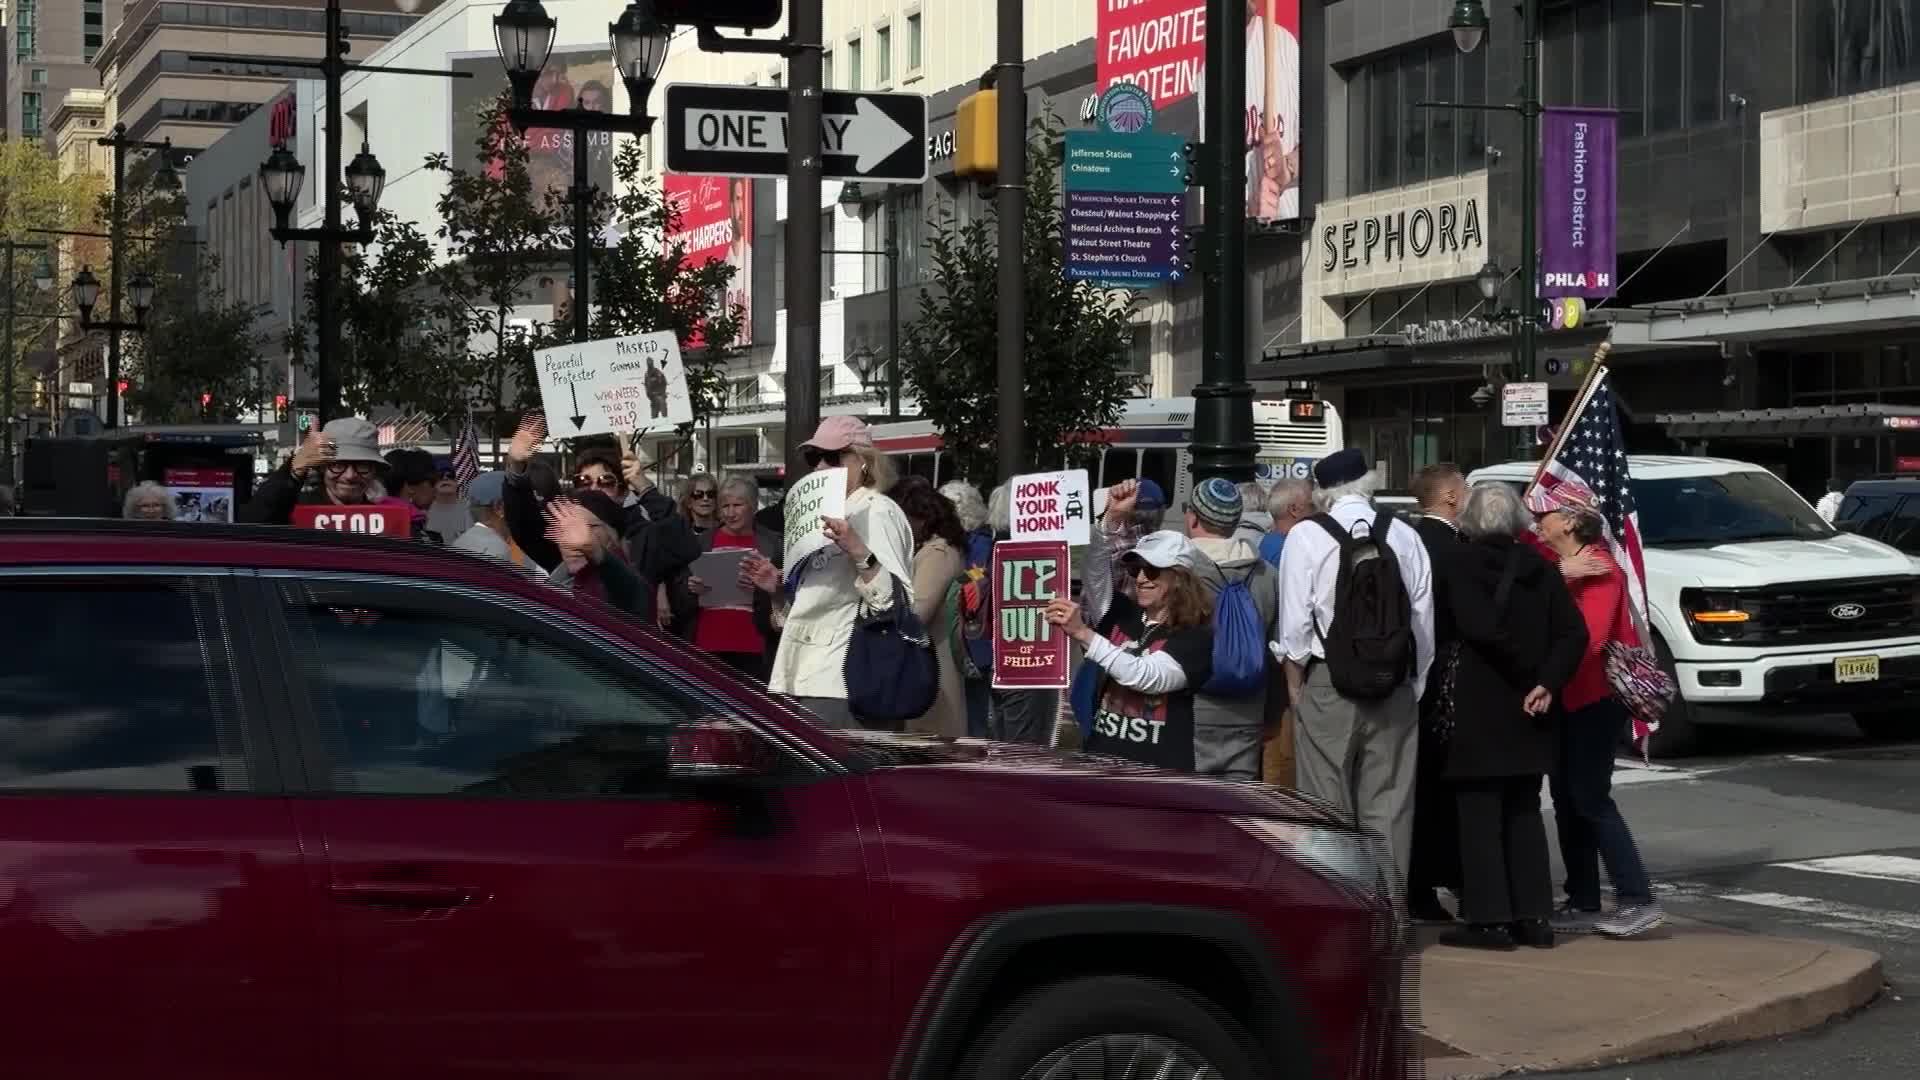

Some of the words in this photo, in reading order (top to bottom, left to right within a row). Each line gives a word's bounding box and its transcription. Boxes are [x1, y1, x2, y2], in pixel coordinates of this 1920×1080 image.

[1107, 5, 1206, 64] FAVORITE
[540, 132, 609, 149] ASSMB
[697, 113, 767, 148] ONE
[781, 116, 851, 151] AY
[1071, 149, 1104, 159] Jefferson
[1105, 150, 1132, 159] Station
[1573, 122, 1588, 184] Fashion
[1071, 163, 1110, 173] Chinatown
[1071, 208, 1134, 219] Chestnut/Walnut
[1135, 210, 1170, 221] Shopping
[1572, 188, 1587, 248] District
[693, 218, 733, 252] HARPER'S
[1071, 224, 1102, 232] National
[1103, 225, 1135, 234] Archives
[1136, 226, 1162, 234] Branch
[1323, 199, 1481, 272] SEPHORA
[1071, 238, 1097, 247] Walnut
[1099, 239, 1121, 248] Street
[1122, 240, 1151, 249] Theatre
[1071, 253, 1081, 261] St.
[1082, 253, 1120, 263] Stephen's
[1120, 254, 1147, 263] Church
[616, 340, 658, 355] MASKED
[545, 352, 584, 372] Peaceful
[553, 369, 596, 386] Protester
[594, 388, 613, 401] WHO
[615, 386, 640, 400] NEEDS
[601, 402, 611, 414] TO
[625, 401, 636, 411] TO
[1299, 403, 1314, 417] 17
[609, 410, 637, 429] JAIL?
[1271, 462, 1309, 479] BIG
[797, 476, 829, 498] your
[1015, 480, 1061, 499] HONK
[1016, 499, 1057, 516] YOUR
[1016, 514, 1064, 533] HORN!
[1002, 560, 1057, 601] ICE
[1838, 606, 1860, 617] Ford
[1000, 606, 1052, 642] OUT
[1020, 645, 1034, 654] OF
[1003, 654, 1055, 668] PHILLY
[1095, 708, 1166, 744] ESIST
